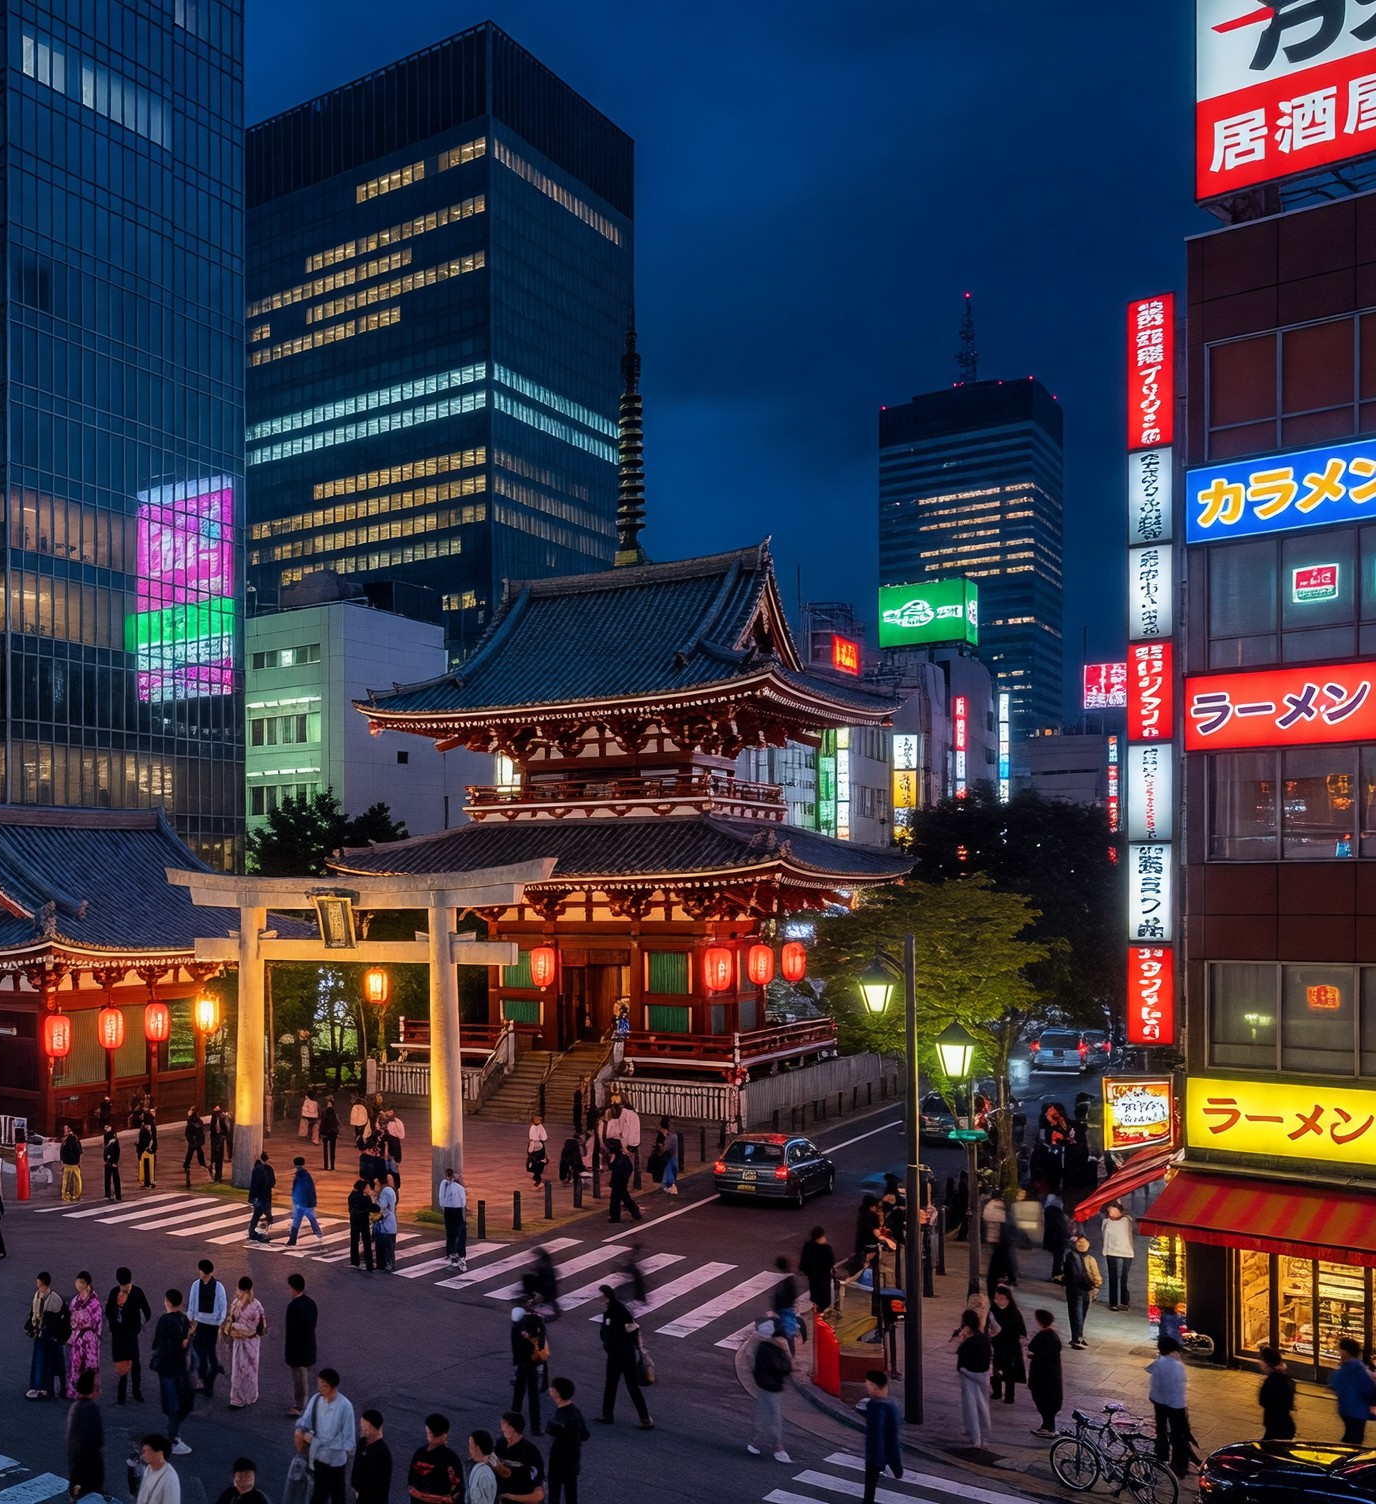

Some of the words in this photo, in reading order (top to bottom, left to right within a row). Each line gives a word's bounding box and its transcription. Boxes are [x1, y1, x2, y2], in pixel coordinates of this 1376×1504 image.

[1191, 681, 1371, 735] ラーメン
[1203, 1098, 1375, 1145] ラーメン
